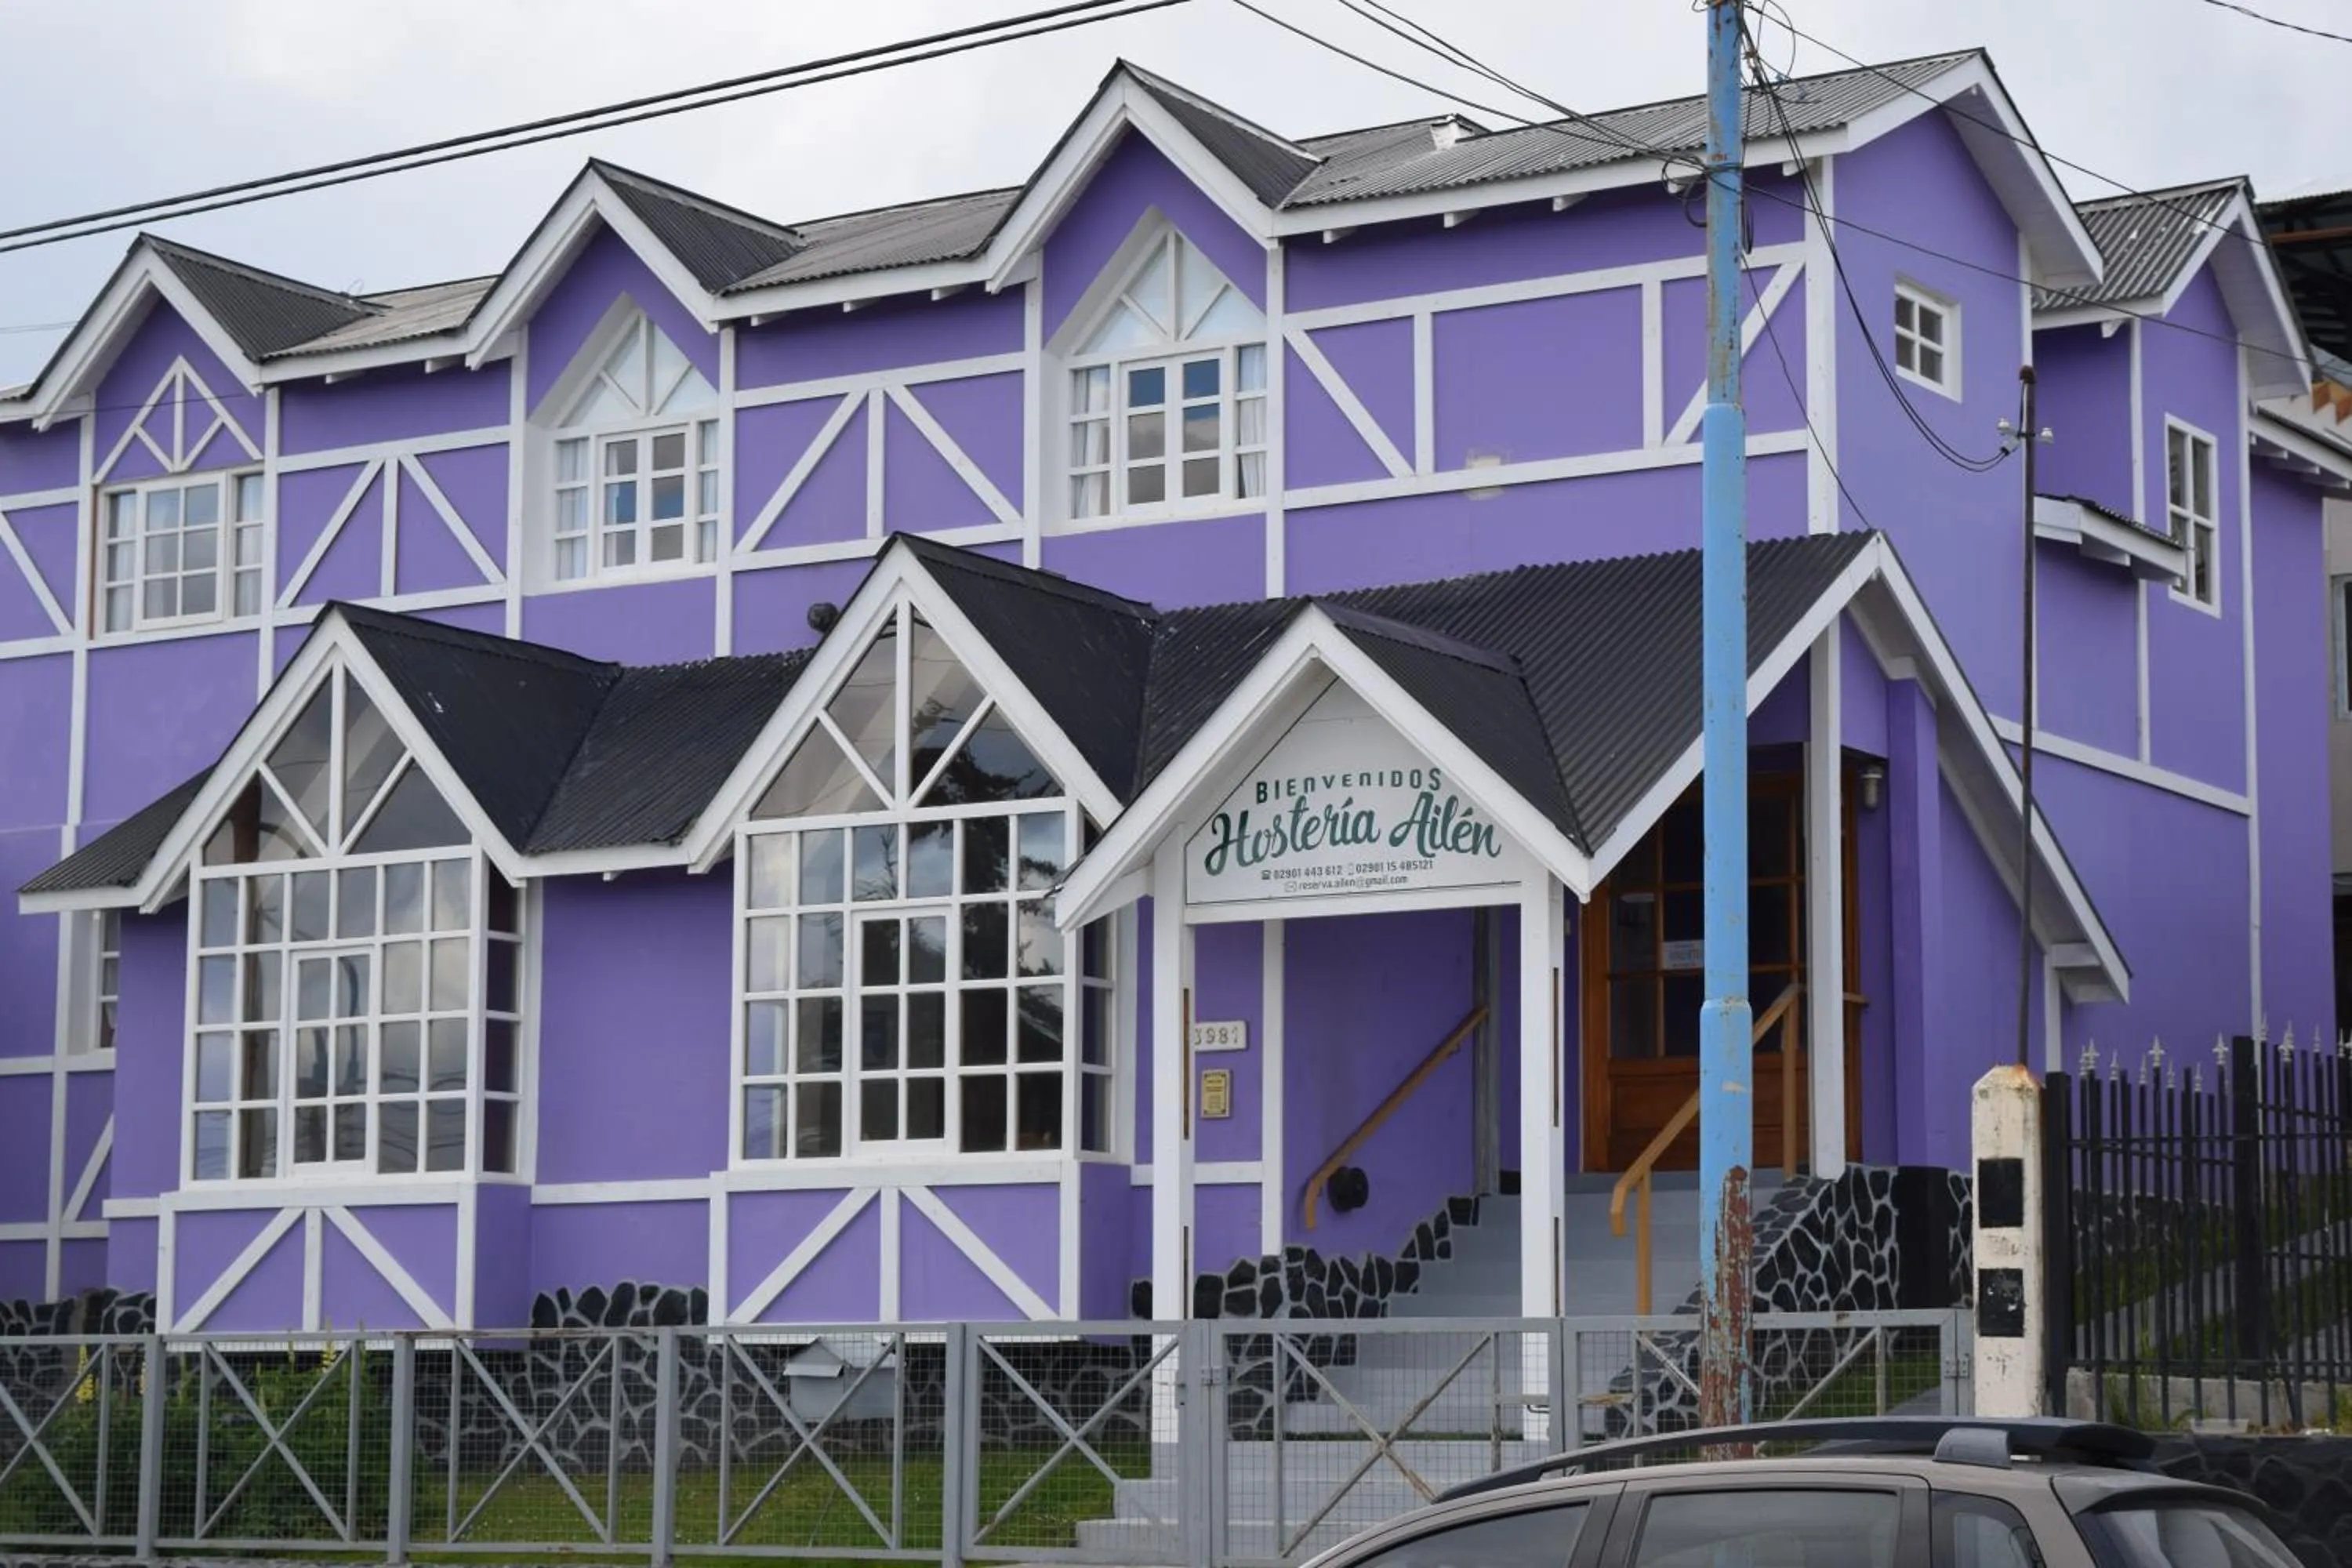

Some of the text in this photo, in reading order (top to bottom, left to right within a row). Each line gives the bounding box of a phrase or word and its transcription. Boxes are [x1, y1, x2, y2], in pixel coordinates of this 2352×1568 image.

[1255, 767, 1443, 804] BIENVENIDOS
[1204, 791, 1501, 877] Hostería Ailén
[1274, 868, 1301, 880] 02901
[1305, 866, 1323, 877] 443
[1356, 862, 1385, 874] 02901
[1387, 861, 1397, 872] 15
